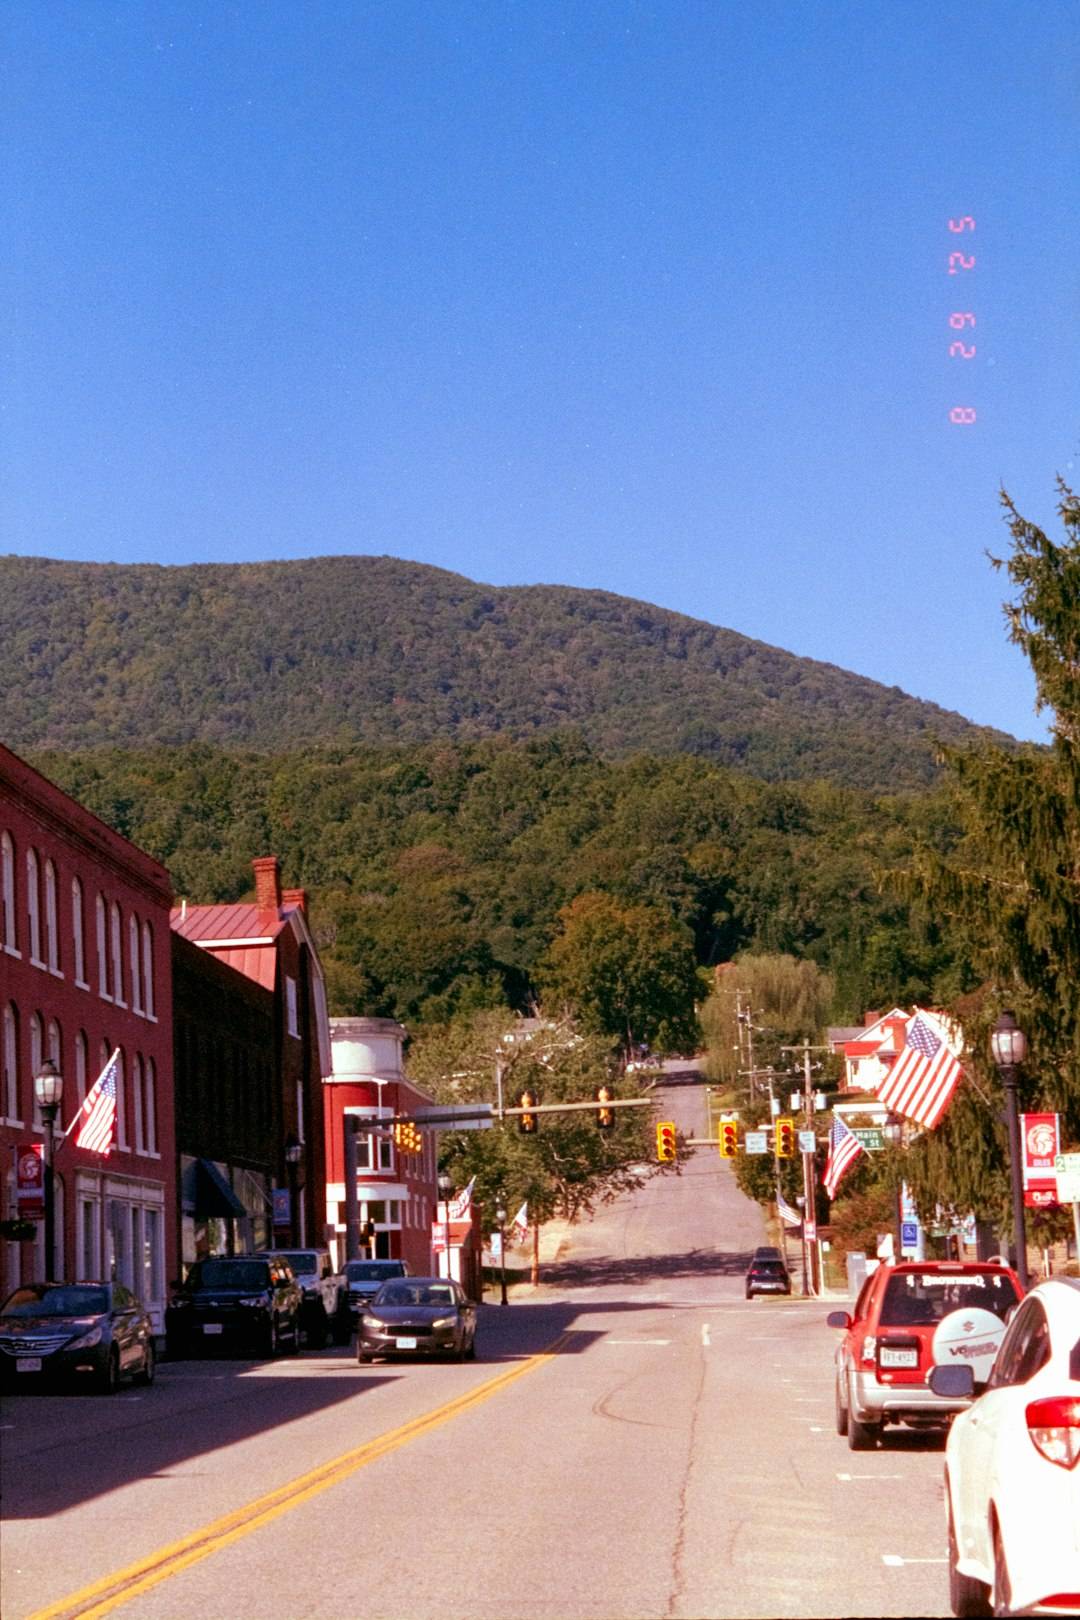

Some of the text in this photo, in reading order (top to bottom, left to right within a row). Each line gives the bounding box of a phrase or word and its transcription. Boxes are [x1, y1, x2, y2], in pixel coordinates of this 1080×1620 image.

[856, 1131, 879, 1139] Main
[870, 1139, 880, 1147] St
[1056, 1157, 1065, 1171] 2
